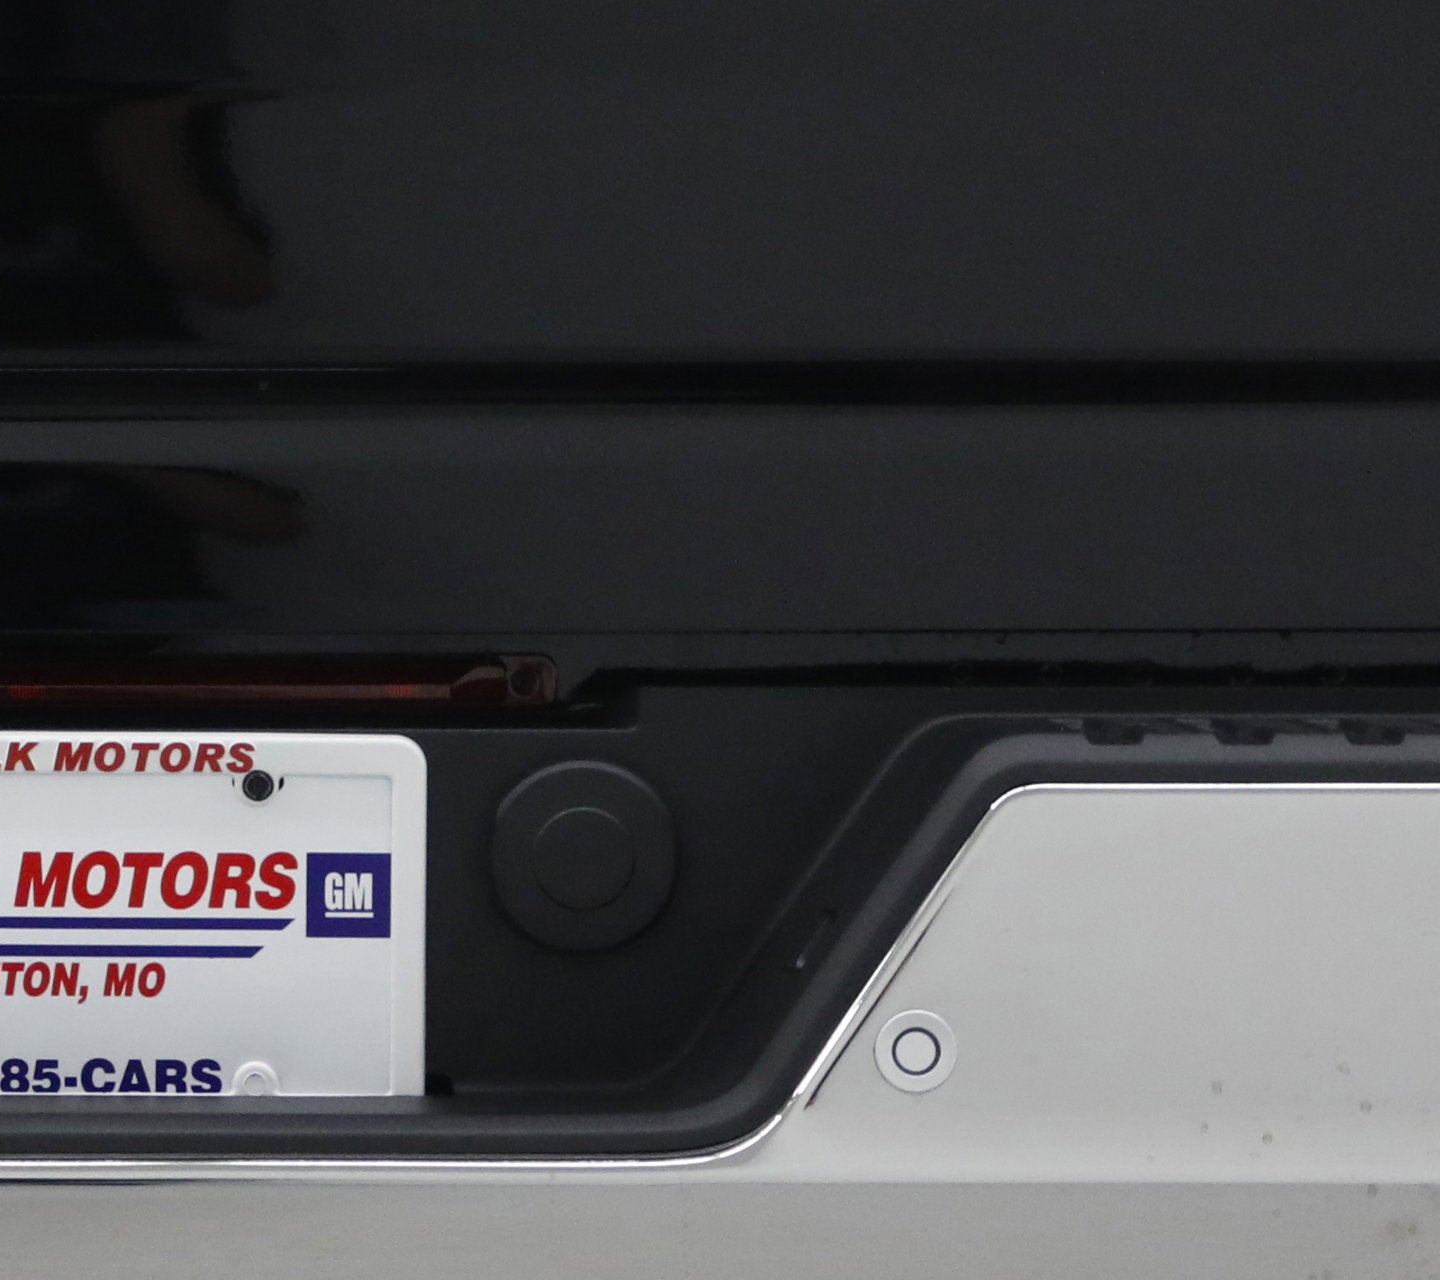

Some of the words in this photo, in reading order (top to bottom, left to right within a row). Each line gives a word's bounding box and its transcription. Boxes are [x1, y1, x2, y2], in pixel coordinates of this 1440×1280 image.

[54, 740, 256, 774] MOTORS
[14, 850, 299, 910] MOTORS
[323, 871, 374, 912] GM
[104, 961, 167, 998] MO
